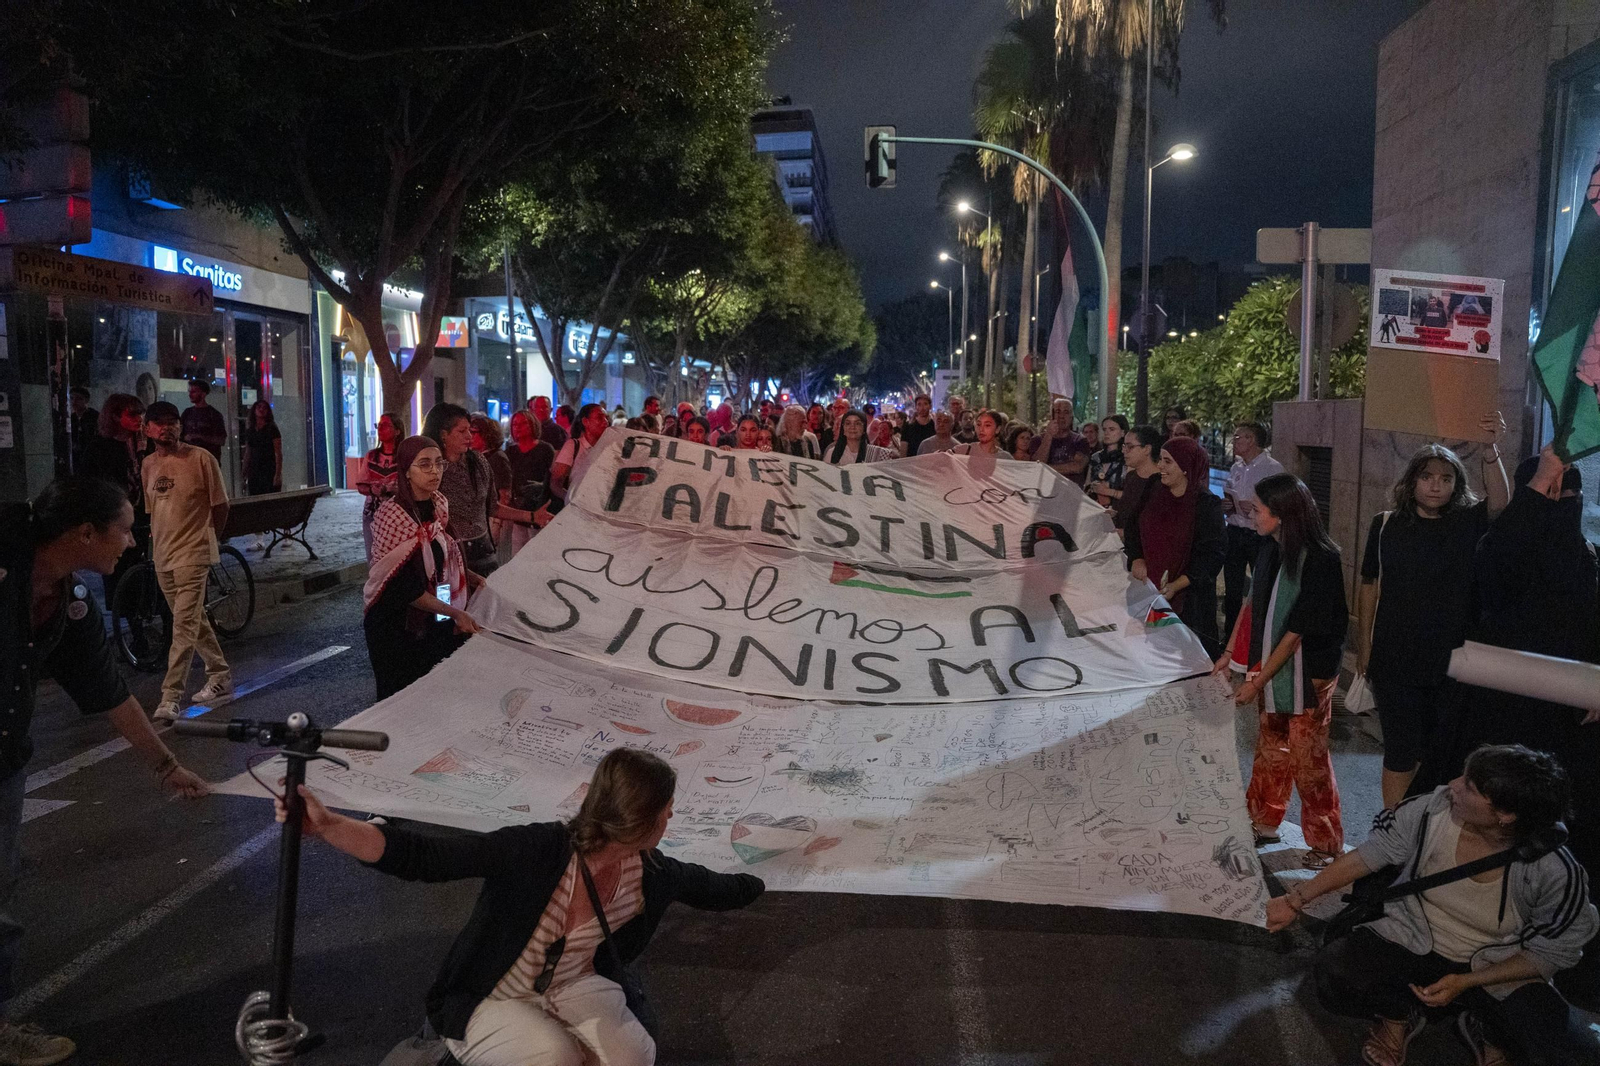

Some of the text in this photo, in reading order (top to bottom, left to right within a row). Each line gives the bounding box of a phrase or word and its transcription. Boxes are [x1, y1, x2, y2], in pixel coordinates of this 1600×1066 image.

[18, 252, 74, 273] Oficina
[129, 271, 145, 284] de
[18, 269, 108, 296] Información
[182, 257, 242, 291] Sanitas
[621, 435, 907, 502] ALMERIA
[604, 466, 1079, 562] PALESTINA
[562, 548, 1118, 651] aislemos AL
[516, 578, 1083, 697] SIONISMO
[1117, 852, 1173, 867] CADA
